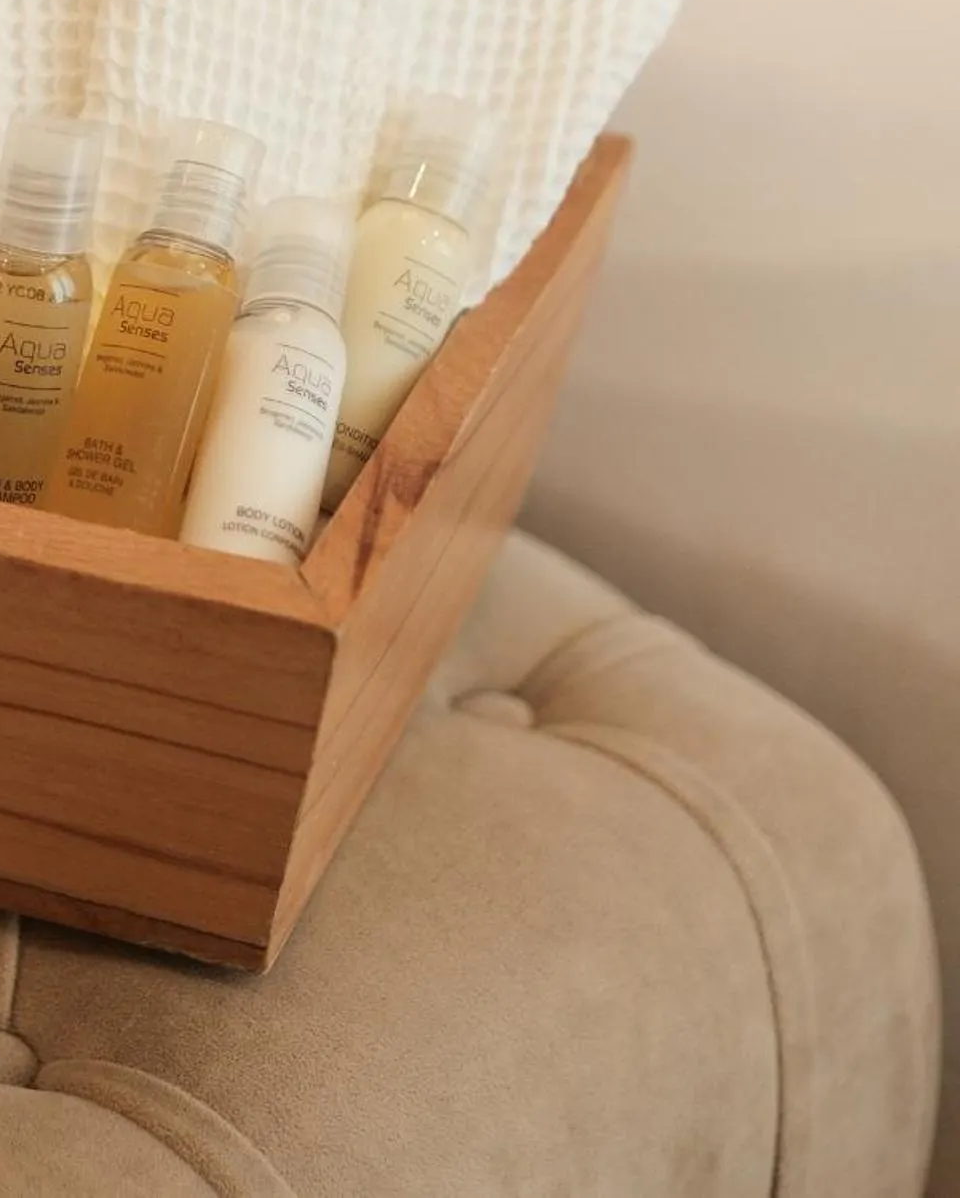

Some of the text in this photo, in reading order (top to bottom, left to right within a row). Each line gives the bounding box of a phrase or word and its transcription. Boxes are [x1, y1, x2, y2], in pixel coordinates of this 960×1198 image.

[110, 294, 175, 327] Aqua
[119, 320, 169, 343] Senses
[13, 360, 63, 376] Senses
[270, 352, 332, 399] Aqua
[285, 379, 328, 412] Senses
[83, 437, 114, 454] BATH
[66, 448, 138, 475] SHOWER GEL
[3, 479, 12, 491] &
[14, 479, 45, 492] BODY
[235, 504, 274, 523] BODY
